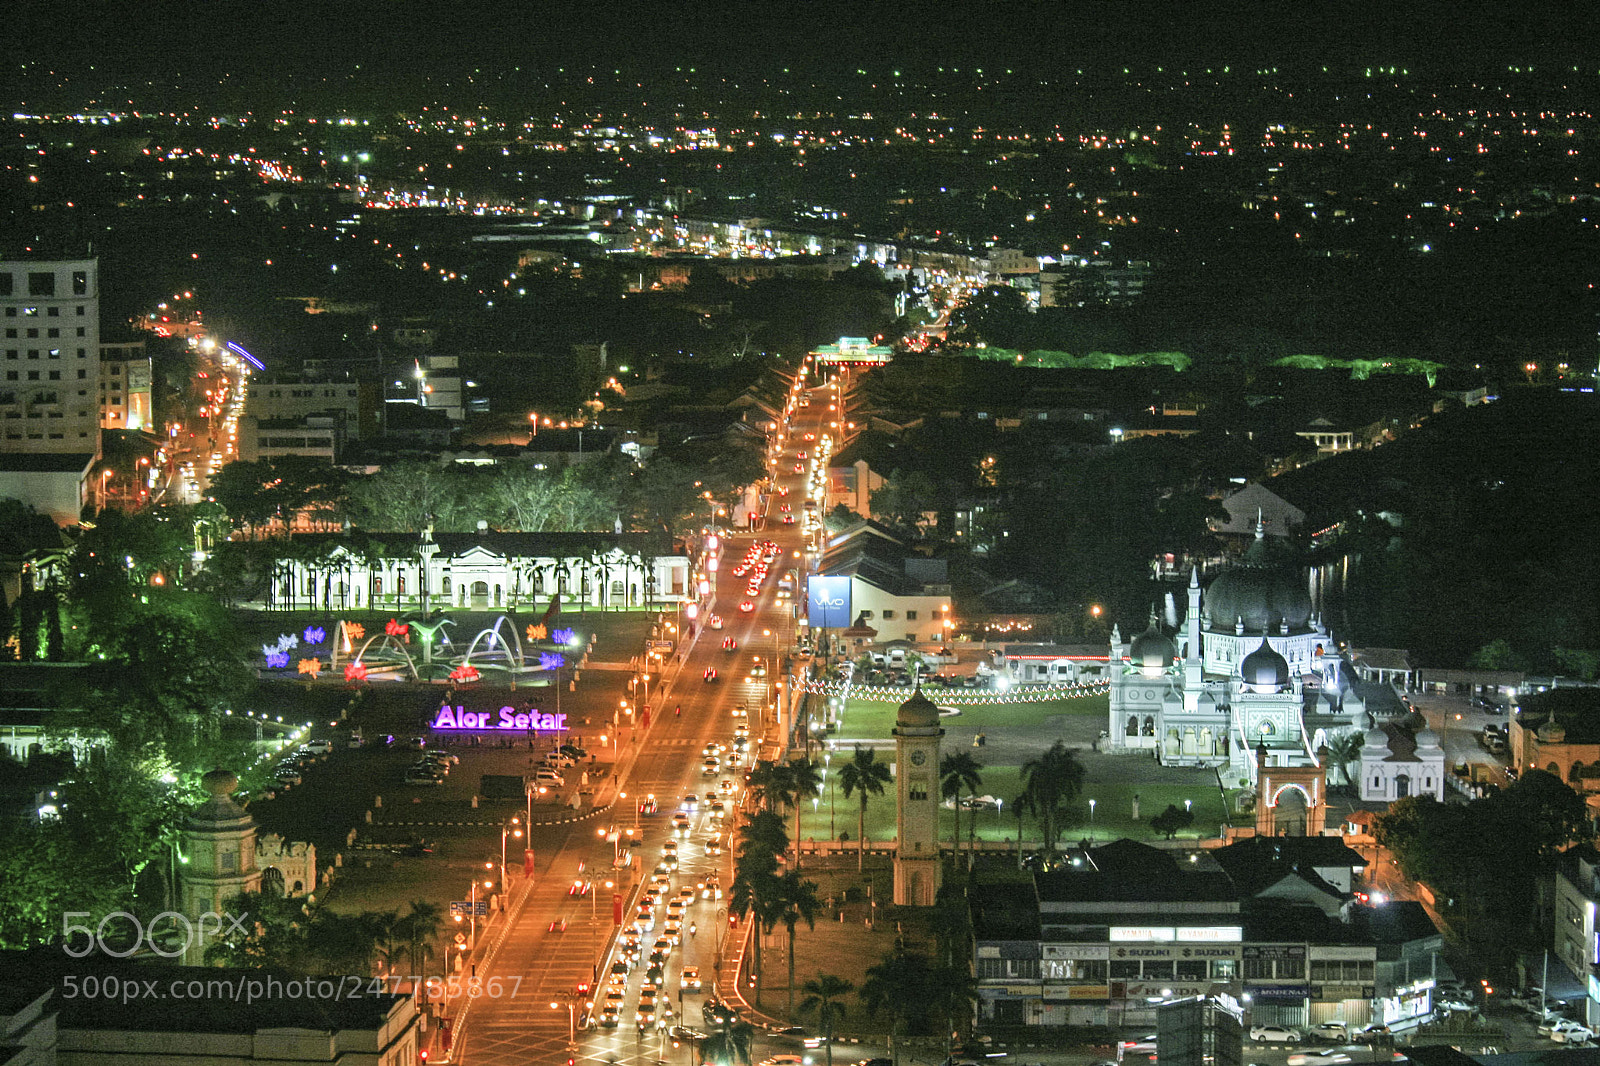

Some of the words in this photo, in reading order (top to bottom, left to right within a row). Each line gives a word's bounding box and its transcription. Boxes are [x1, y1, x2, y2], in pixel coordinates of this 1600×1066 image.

[435, 705, 491, 728] Alor
[498, 706, 567, 729] Setar
[1121, 929, 1153, 938] YAMAHA
[1187, 930, 1219, 938] YAMAHA
[1129, 948, 1170, 957] SUZUKI
[1194, 948, 1235, 957] SUZUKI
